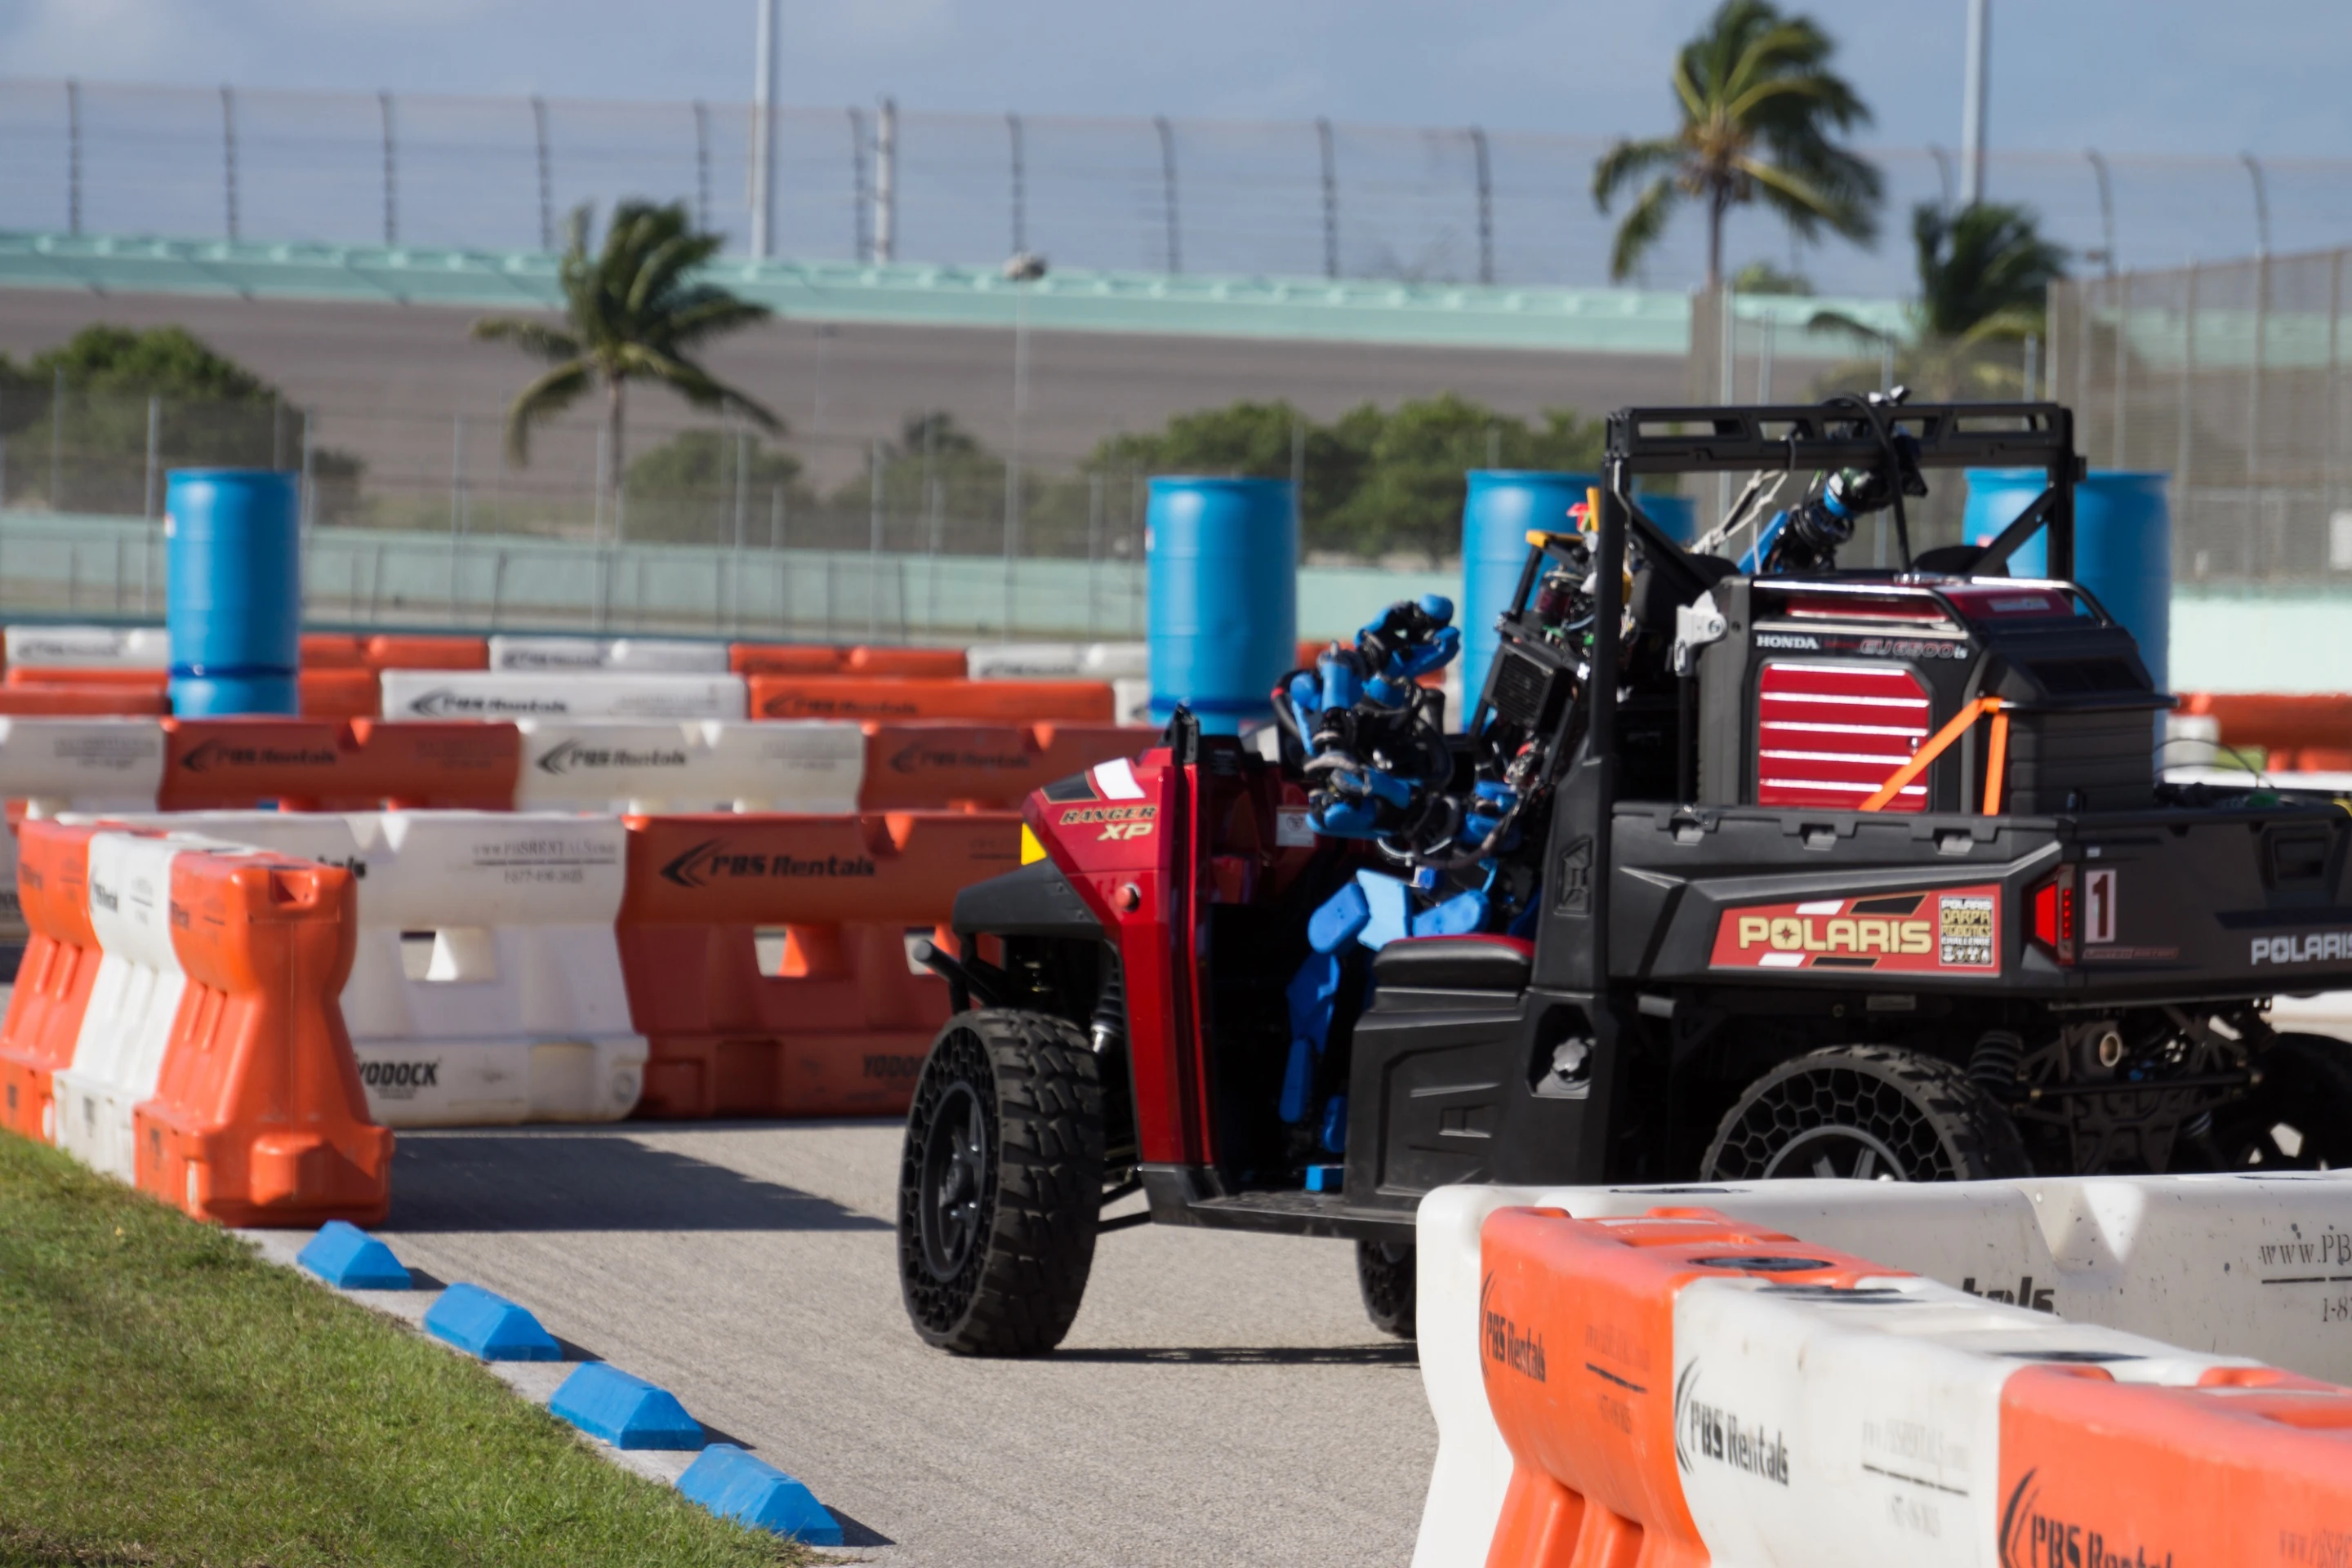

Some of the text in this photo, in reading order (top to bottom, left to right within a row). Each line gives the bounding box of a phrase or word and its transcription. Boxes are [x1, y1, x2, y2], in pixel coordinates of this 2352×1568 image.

[1757, 635, 1819, 649] HONDA
[1059, 805, 1157, 825] RANGER
[1097, 822, 1154, 841] XP
[710, 854, 876, 877] PBS Rentals
[2092, 873, 2109, 939] 1
[1942, 909, 1991, 925] DARPA
[1739, 916, 1933, 954] POLARIS
[1942, 924, 1991, 938] ROBOTICS
[1486, 1310, 1506, 1363] PBS
[1508, 1321, 1546, 1383] Rentals
[1690, 1400, 1724, 1460] PBS
[1727, 1413, 1789, 1487] Rentals
